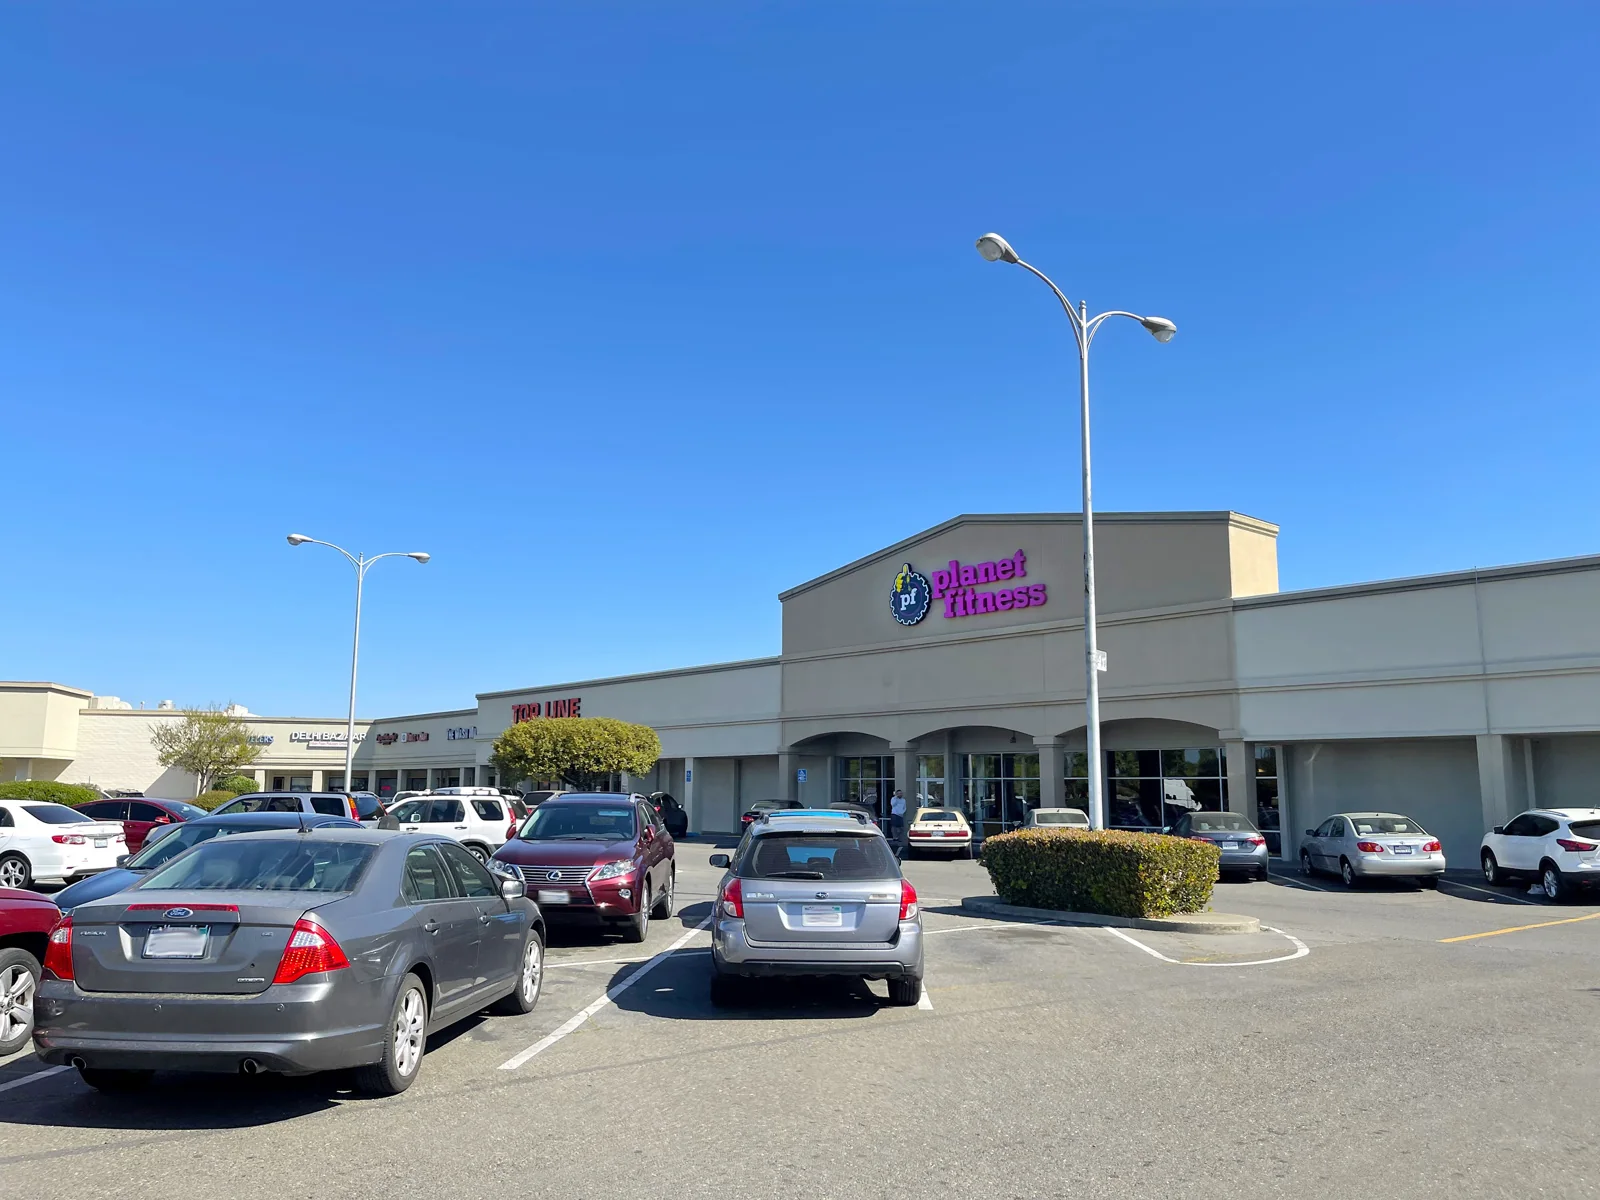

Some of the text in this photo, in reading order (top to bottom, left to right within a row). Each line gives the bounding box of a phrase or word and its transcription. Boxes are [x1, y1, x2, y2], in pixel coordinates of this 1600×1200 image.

[931, 549, 1027, 599] planet
[900, 587, 918, 611] pf
[943, 583, 1047, 618] fitness
[512, 697, 581, 724] TOP LINE
[290, 731, 321, 741] DELHI
